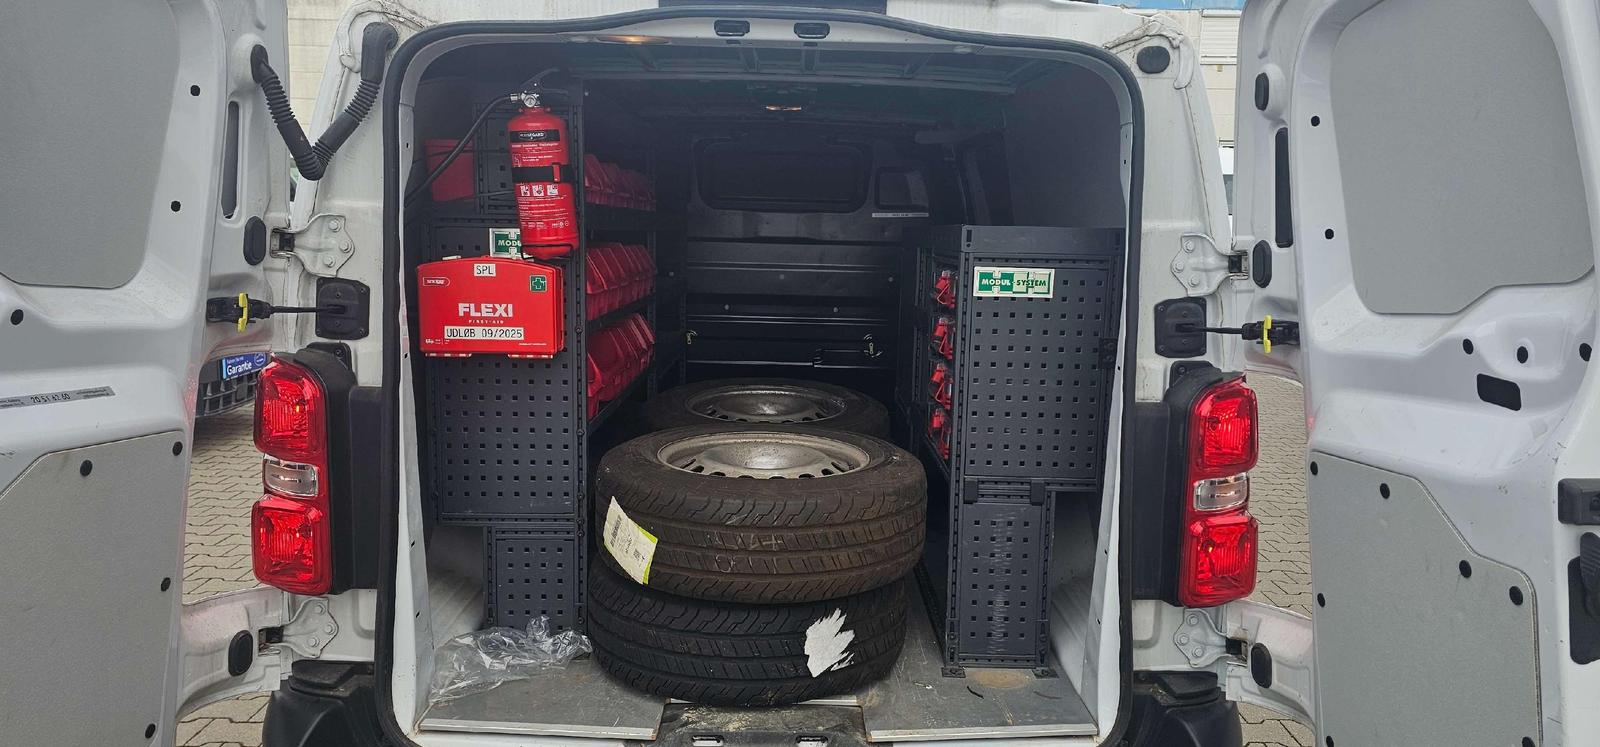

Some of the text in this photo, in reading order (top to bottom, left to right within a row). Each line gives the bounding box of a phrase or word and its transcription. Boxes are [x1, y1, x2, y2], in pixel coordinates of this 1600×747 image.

[476, 265, 494, 275] SPL
[458, 303, 513, 317] FLEXI
[446, 328, 523, 339] UDLØB 09/2025
[226, 360, 252, 376] Garantie
